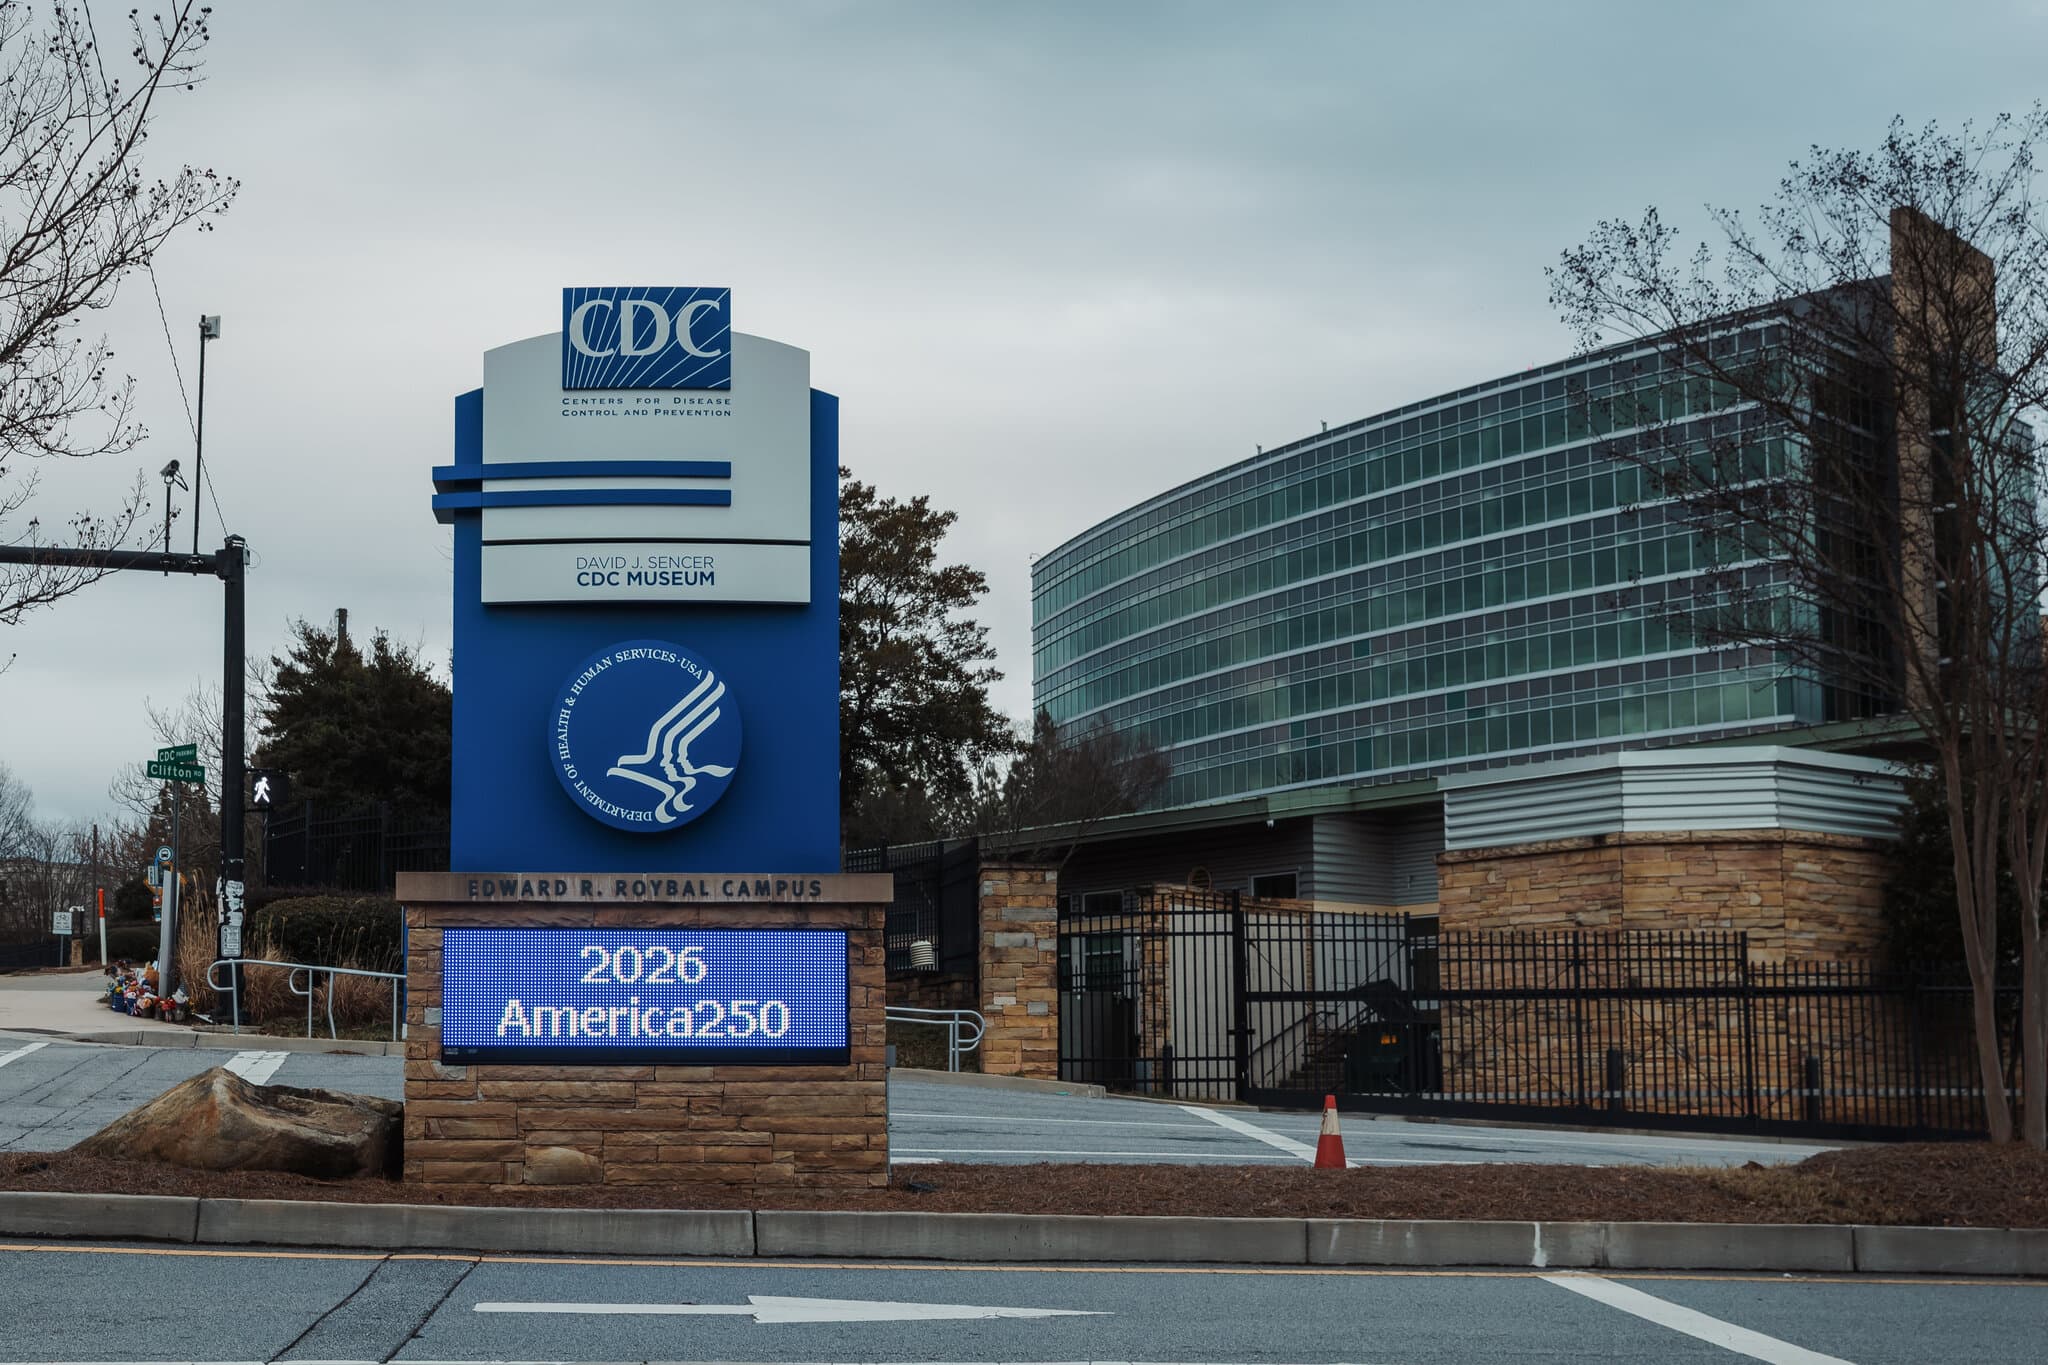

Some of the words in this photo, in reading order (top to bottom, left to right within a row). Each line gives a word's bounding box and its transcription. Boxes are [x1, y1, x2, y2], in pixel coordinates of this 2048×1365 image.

[569, 299, 722, 358] CDC
[654, 408, 731, 417] PREVENTION
[576, 557, 626, 569] DAVID
[648, 556, 714, 569] SENCER
[576, 571, 620, 586] CDC
[627, 571, 715, 586] MUSEUM
[615, 648, 677, 663] SERVICES
[570, 656, 613, 696] HUMAN
[565, 697, 577, 706] &
[558, 708, 571, 761] HEALTH
[159, 750, 175, 762] CDC
[150, 764, 192, 778] Clifton
[563, 763, 578, 779] OF
[574, 780, 653, 822] DEPARTMENT
[468, 879, 567, 897] EDWARD
[581, 879, 602, 897] R.
[615, 879, 709, 897] ROYBAL
[722, 879, 821, 897] CAMPUS
[580, 945, 708, 985] 2026
[496, 997, 792, 1039] America250
